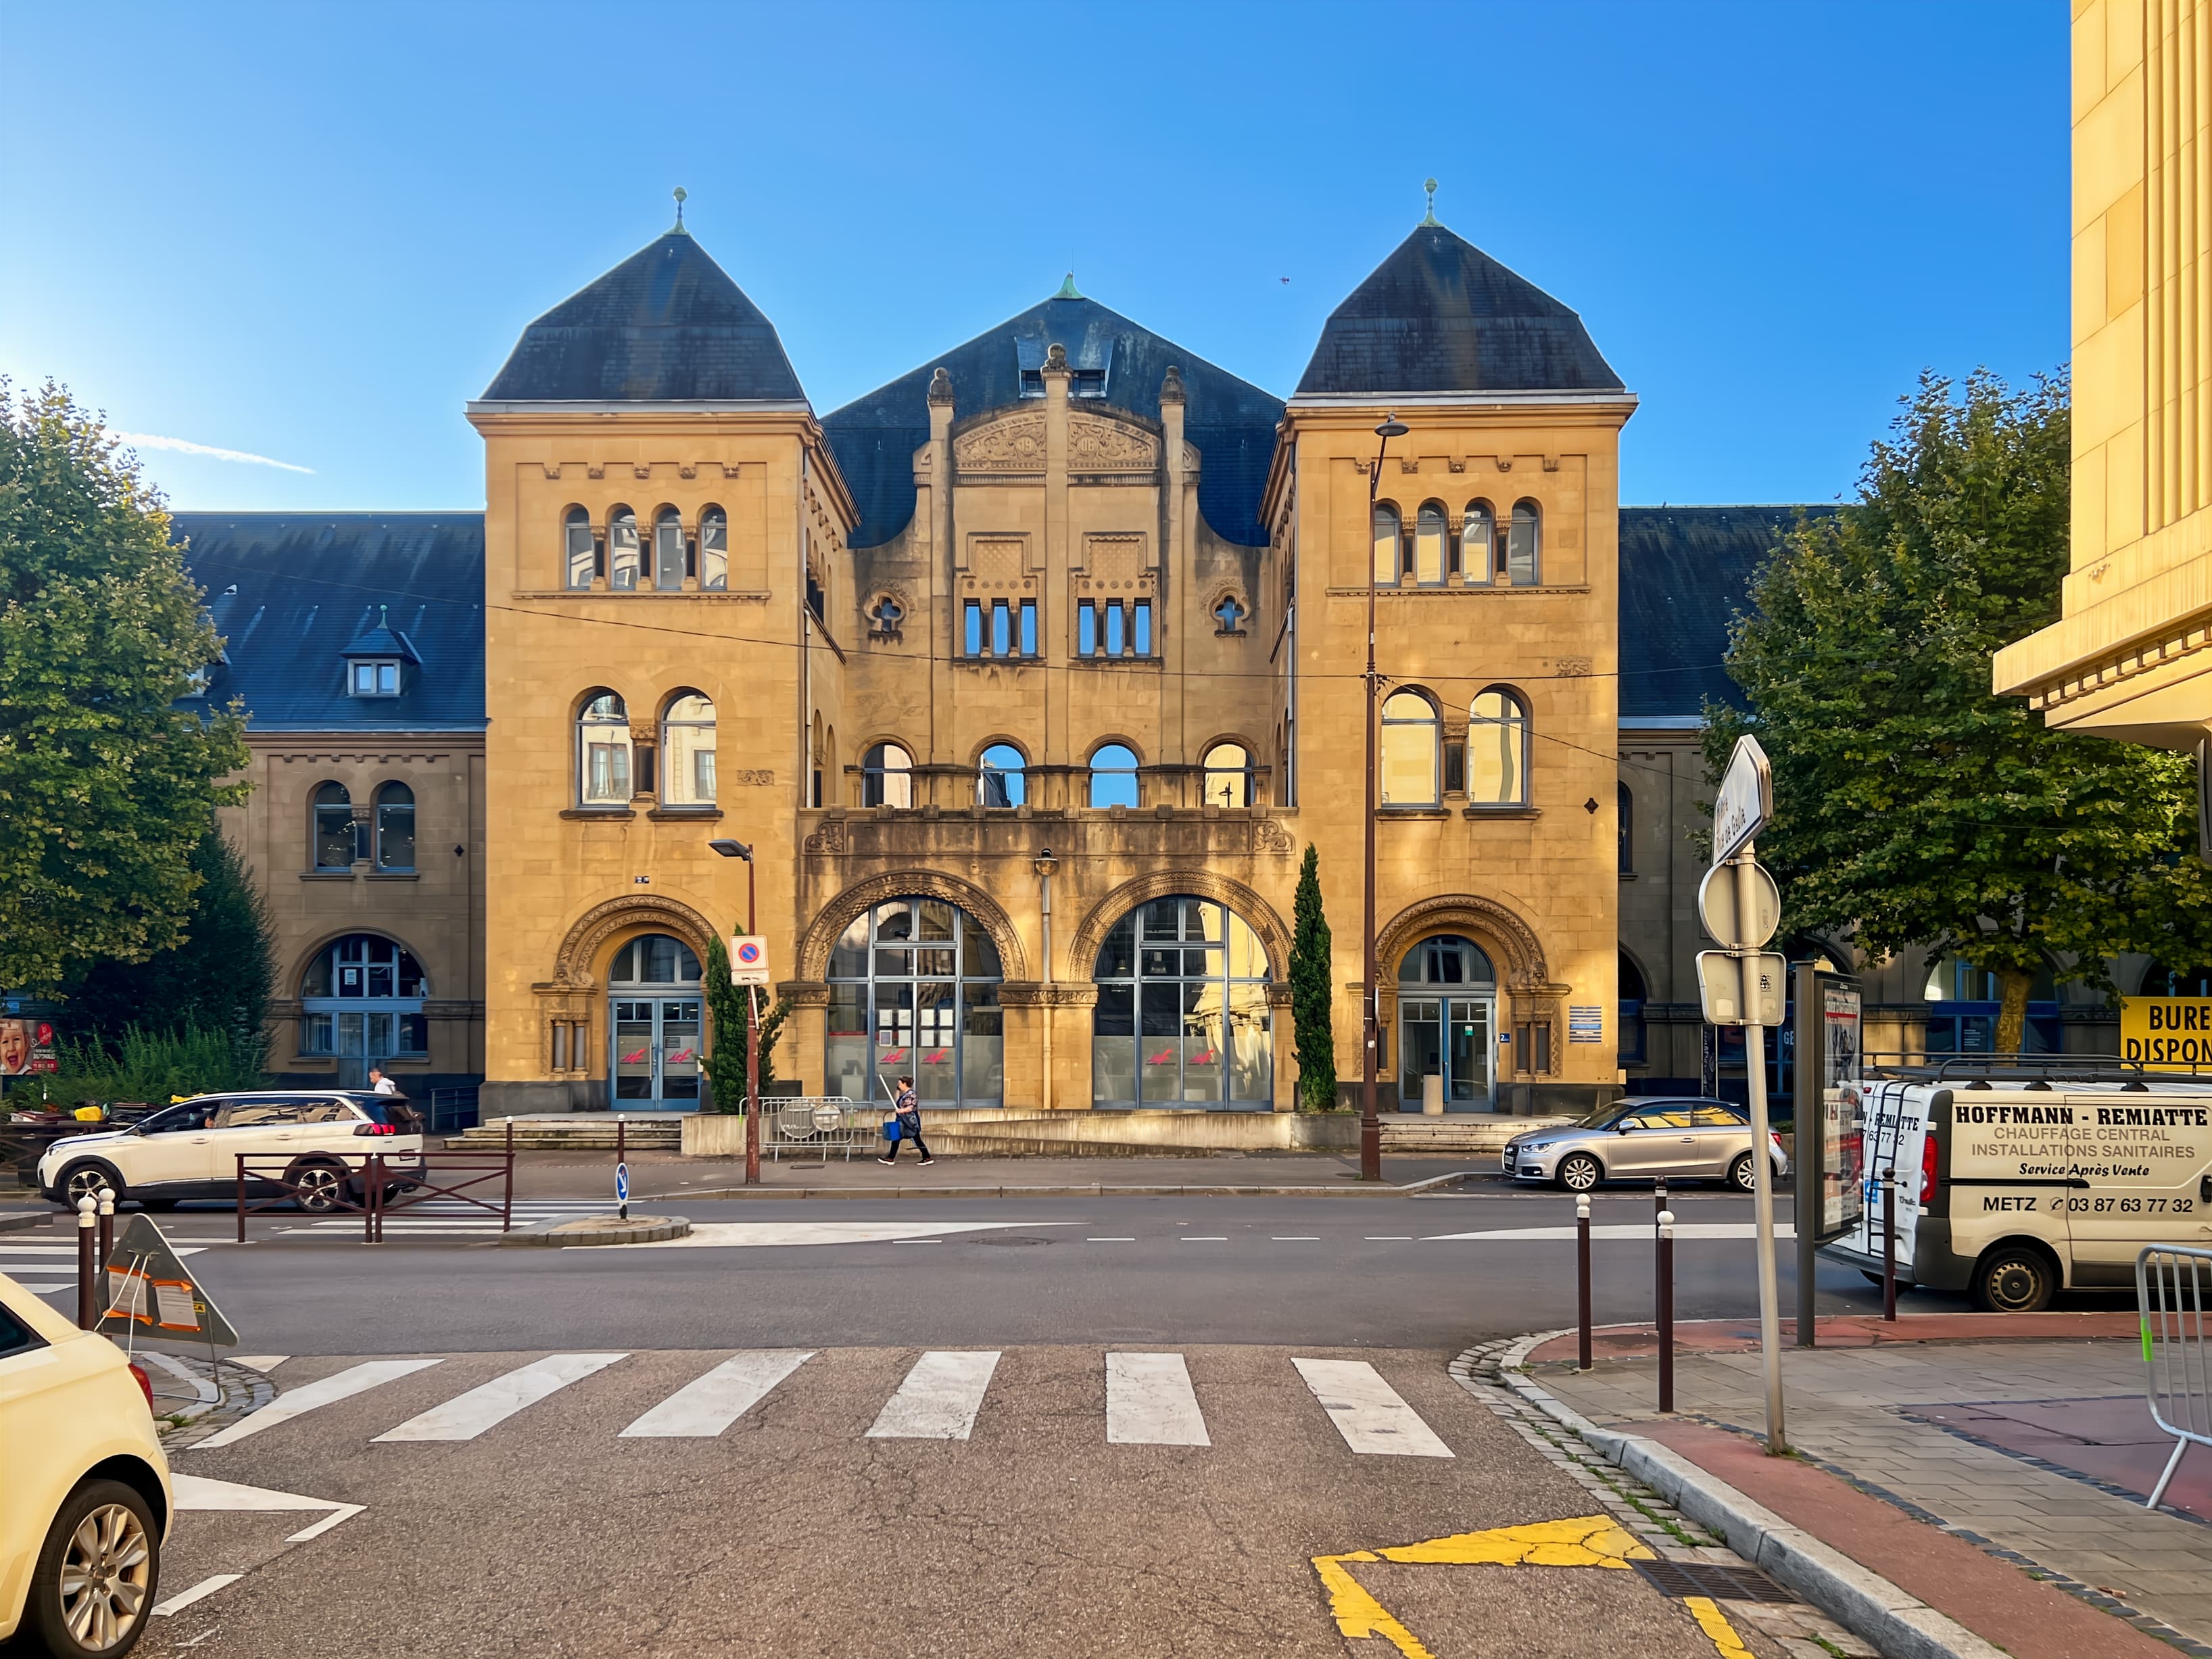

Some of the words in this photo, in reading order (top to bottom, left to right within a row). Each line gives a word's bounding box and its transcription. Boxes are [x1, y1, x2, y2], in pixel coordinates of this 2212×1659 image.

[2149, 1005, 2211, 1030] BURE
[2126, 1038, 2212, 1062] DISPON
[1956, 1106, 2073, 1124] HOFFMANN
[2096, 1108, 2208, 1126] REMIATTE
[1994, 1127, 2092, 1140] CHAUFFAGE
[2096, 1128, 2170, 1141] CENTRAL
[1971, 1144, 2097, 1157] INSTALLATIONS
[2102, 1145, 2195, 1158] SANITAIRES
[2019, 1163, 2065, 1175] Service
[2067, 1163, 2109, 1178] Après
[2113, 1164, 2150, 1176] Vente
[1983, 1197, 2037, 1211] METZ
[2069, 1198, 2089, 1212] 03
[2094, 1198, 2115, 1212] 87
[2120, 1198, 2142, 1212] 63
[2146, 1199, 2168, 1212] 77
[2171, 1199, 2194, 1213] 32
